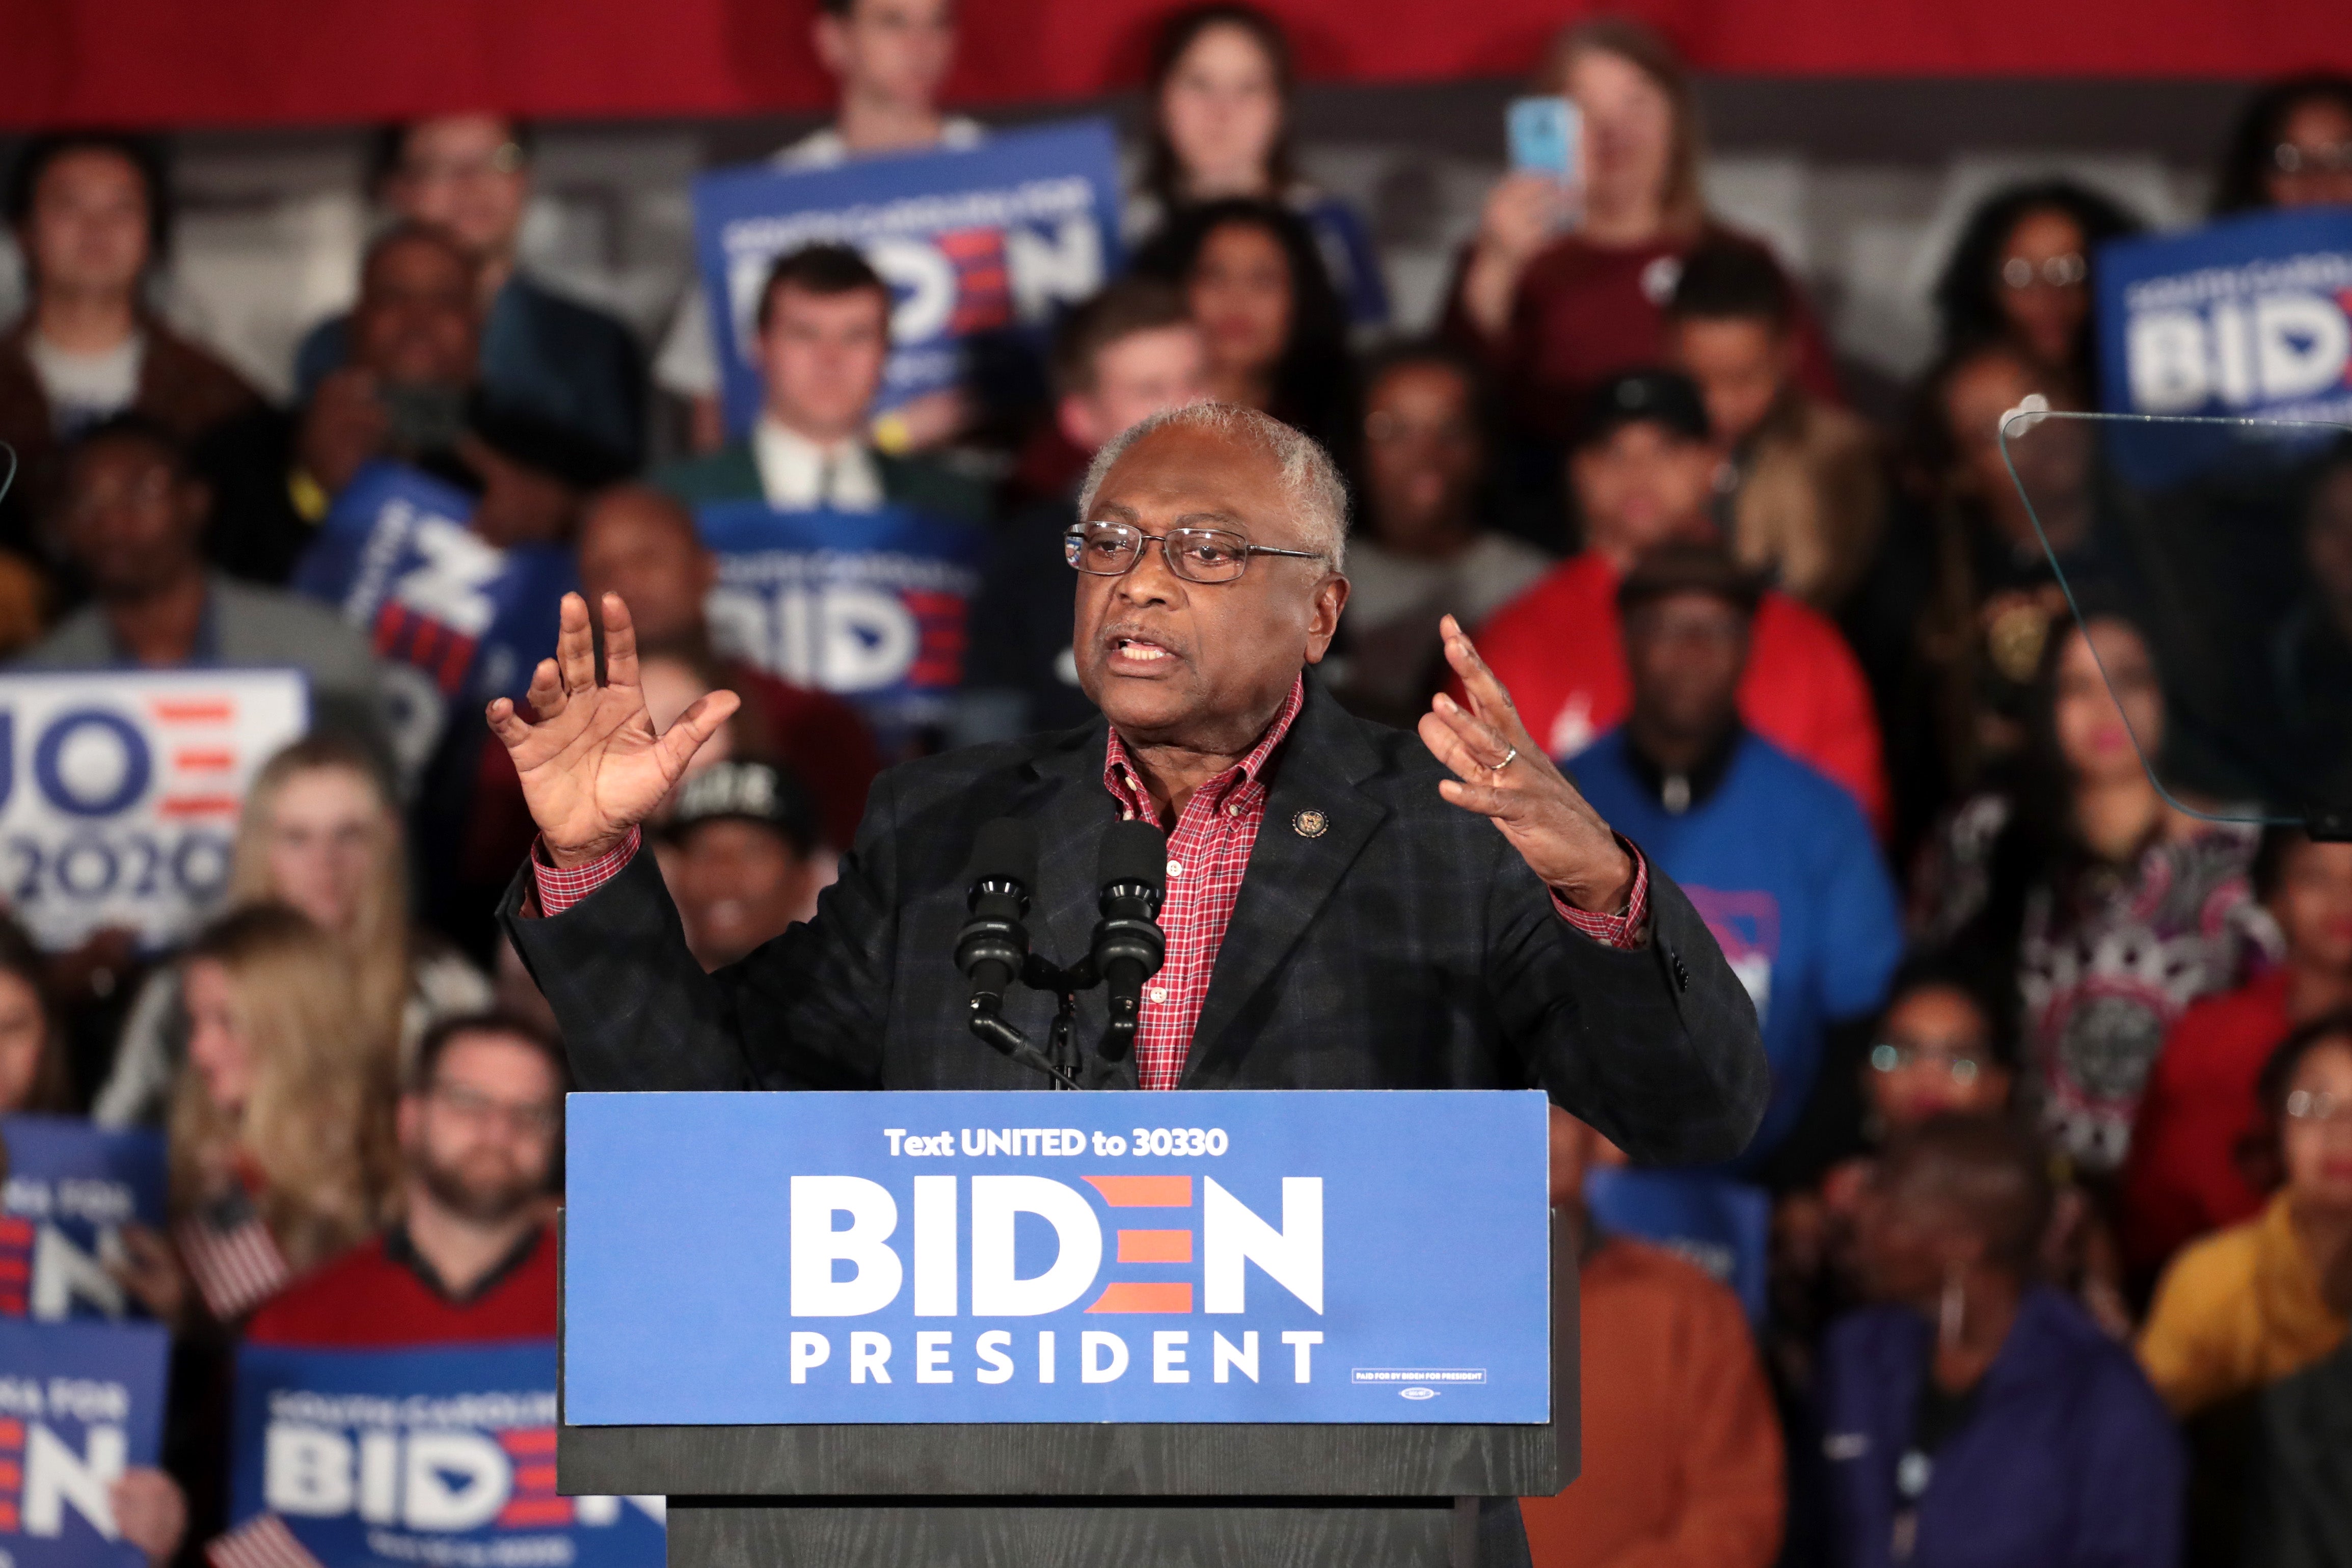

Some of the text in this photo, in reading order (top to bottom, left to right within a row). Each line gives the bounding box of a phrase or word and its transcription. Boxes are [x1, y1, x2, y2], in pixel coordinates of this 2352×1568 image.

[884, 1127, 1228, 1156] Text UNITED to 30330
[791, 1175, 1323, 1316] BIDEN
[791, 1330, 1323, 1385] PRESIDENT
